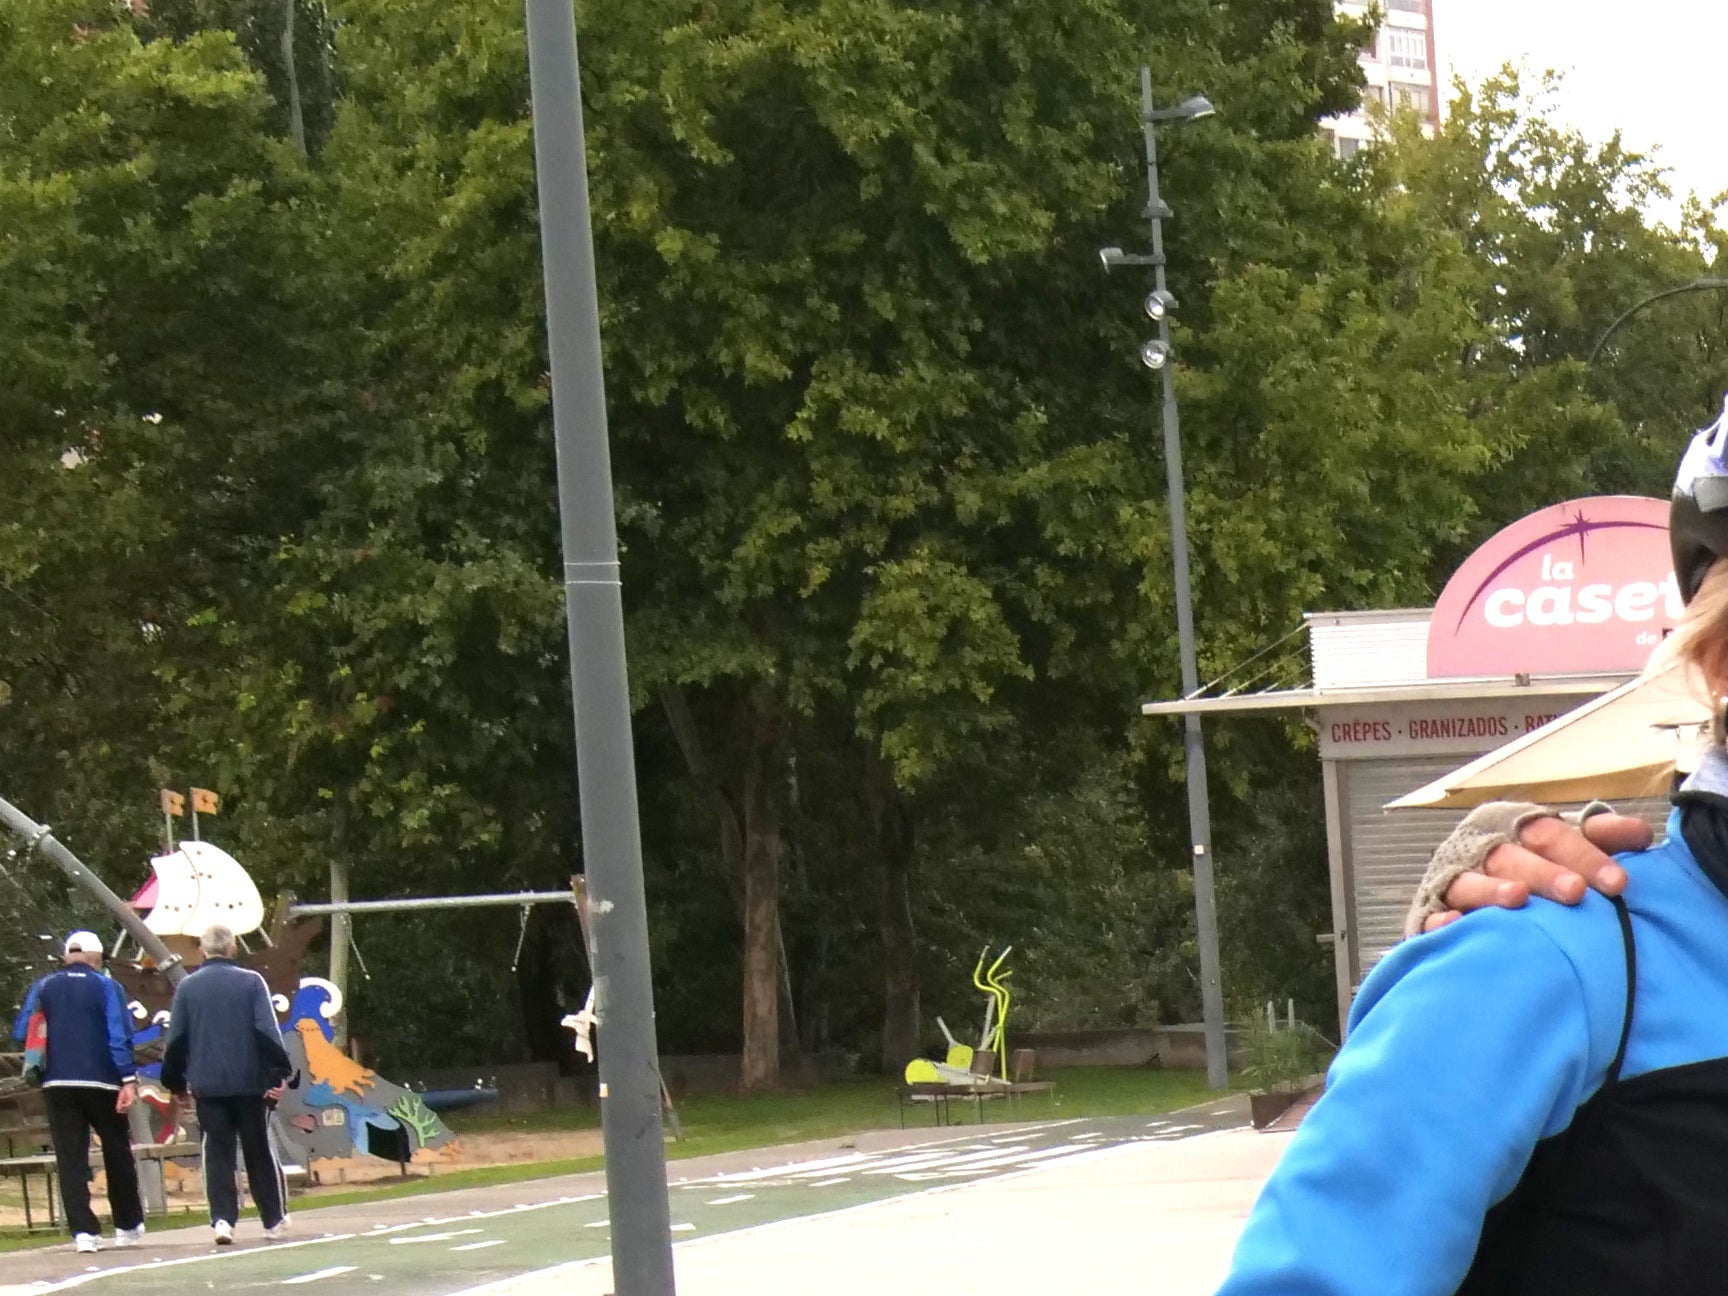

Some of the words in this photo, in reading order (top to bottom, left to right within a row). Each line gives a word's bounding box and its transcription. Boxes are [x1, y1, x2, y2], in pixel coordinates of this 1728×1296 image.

[1541, 554, 1575, 582] la
[1635, 630, 1658, 647] de
[1330, 718, 1392, 744] CRÊPES
[1408, 714, 1509, 741] GRANIZADOS
